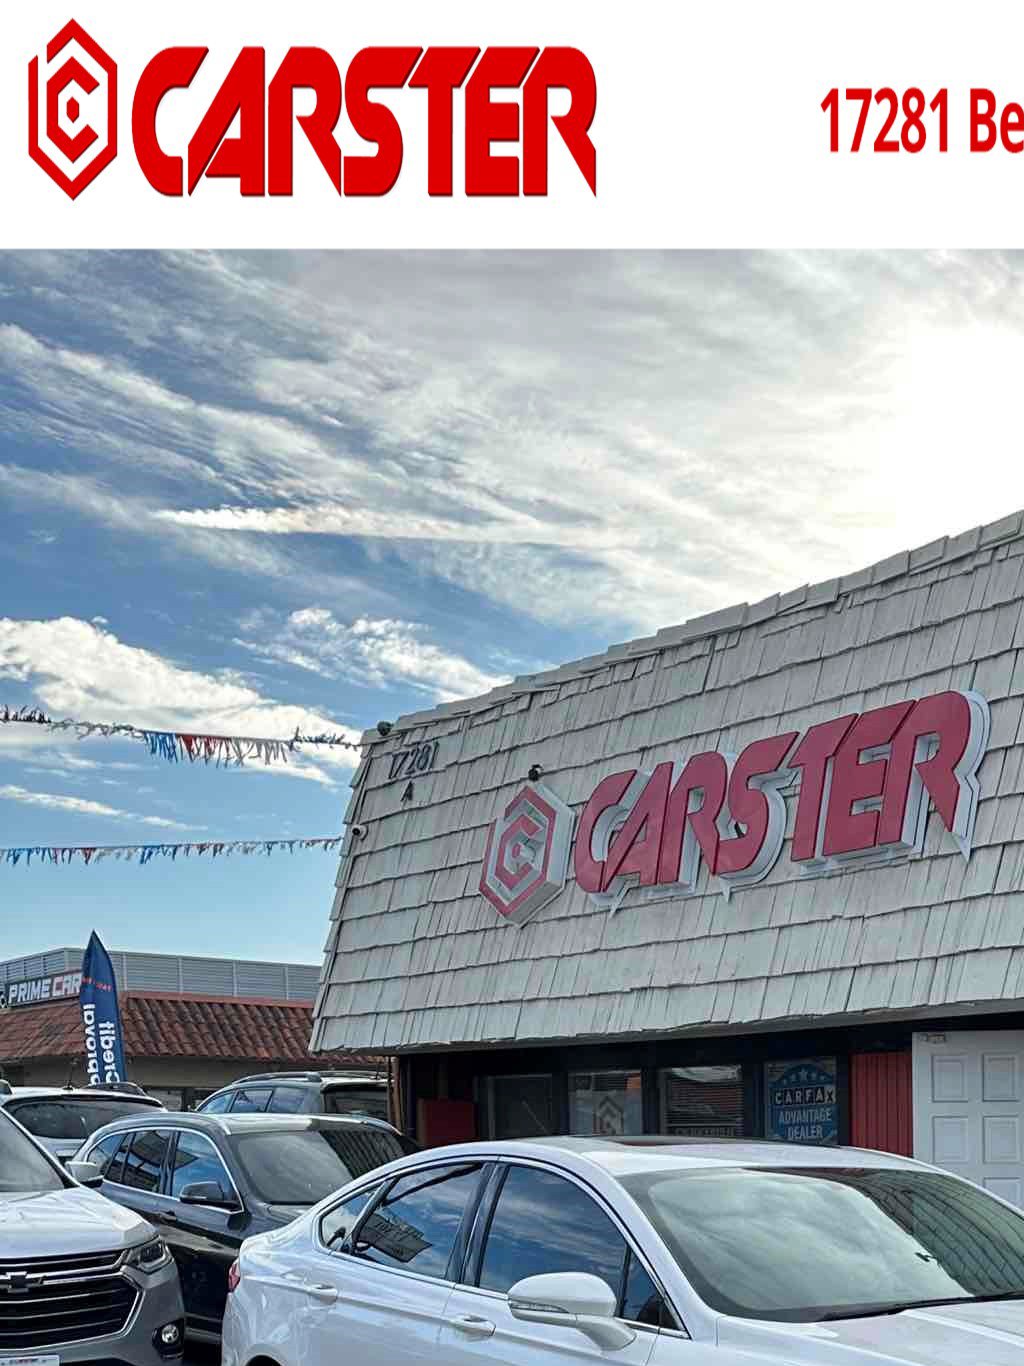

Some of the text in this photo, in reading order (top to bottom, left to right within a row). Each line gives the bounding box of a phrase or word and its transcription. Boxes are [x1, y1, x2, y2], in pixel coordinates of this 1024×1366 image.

[388, 741, 440, 779] 17281
[574, 690, 974, 894] CARSTER
[8, 979, 51, 1003] PRIME
[775, 1086, 837, 1105] CARFAX
[778, 1108, 833, 1124] ADVANTAGE
[786, 1125, 824, 1140] DEALER
